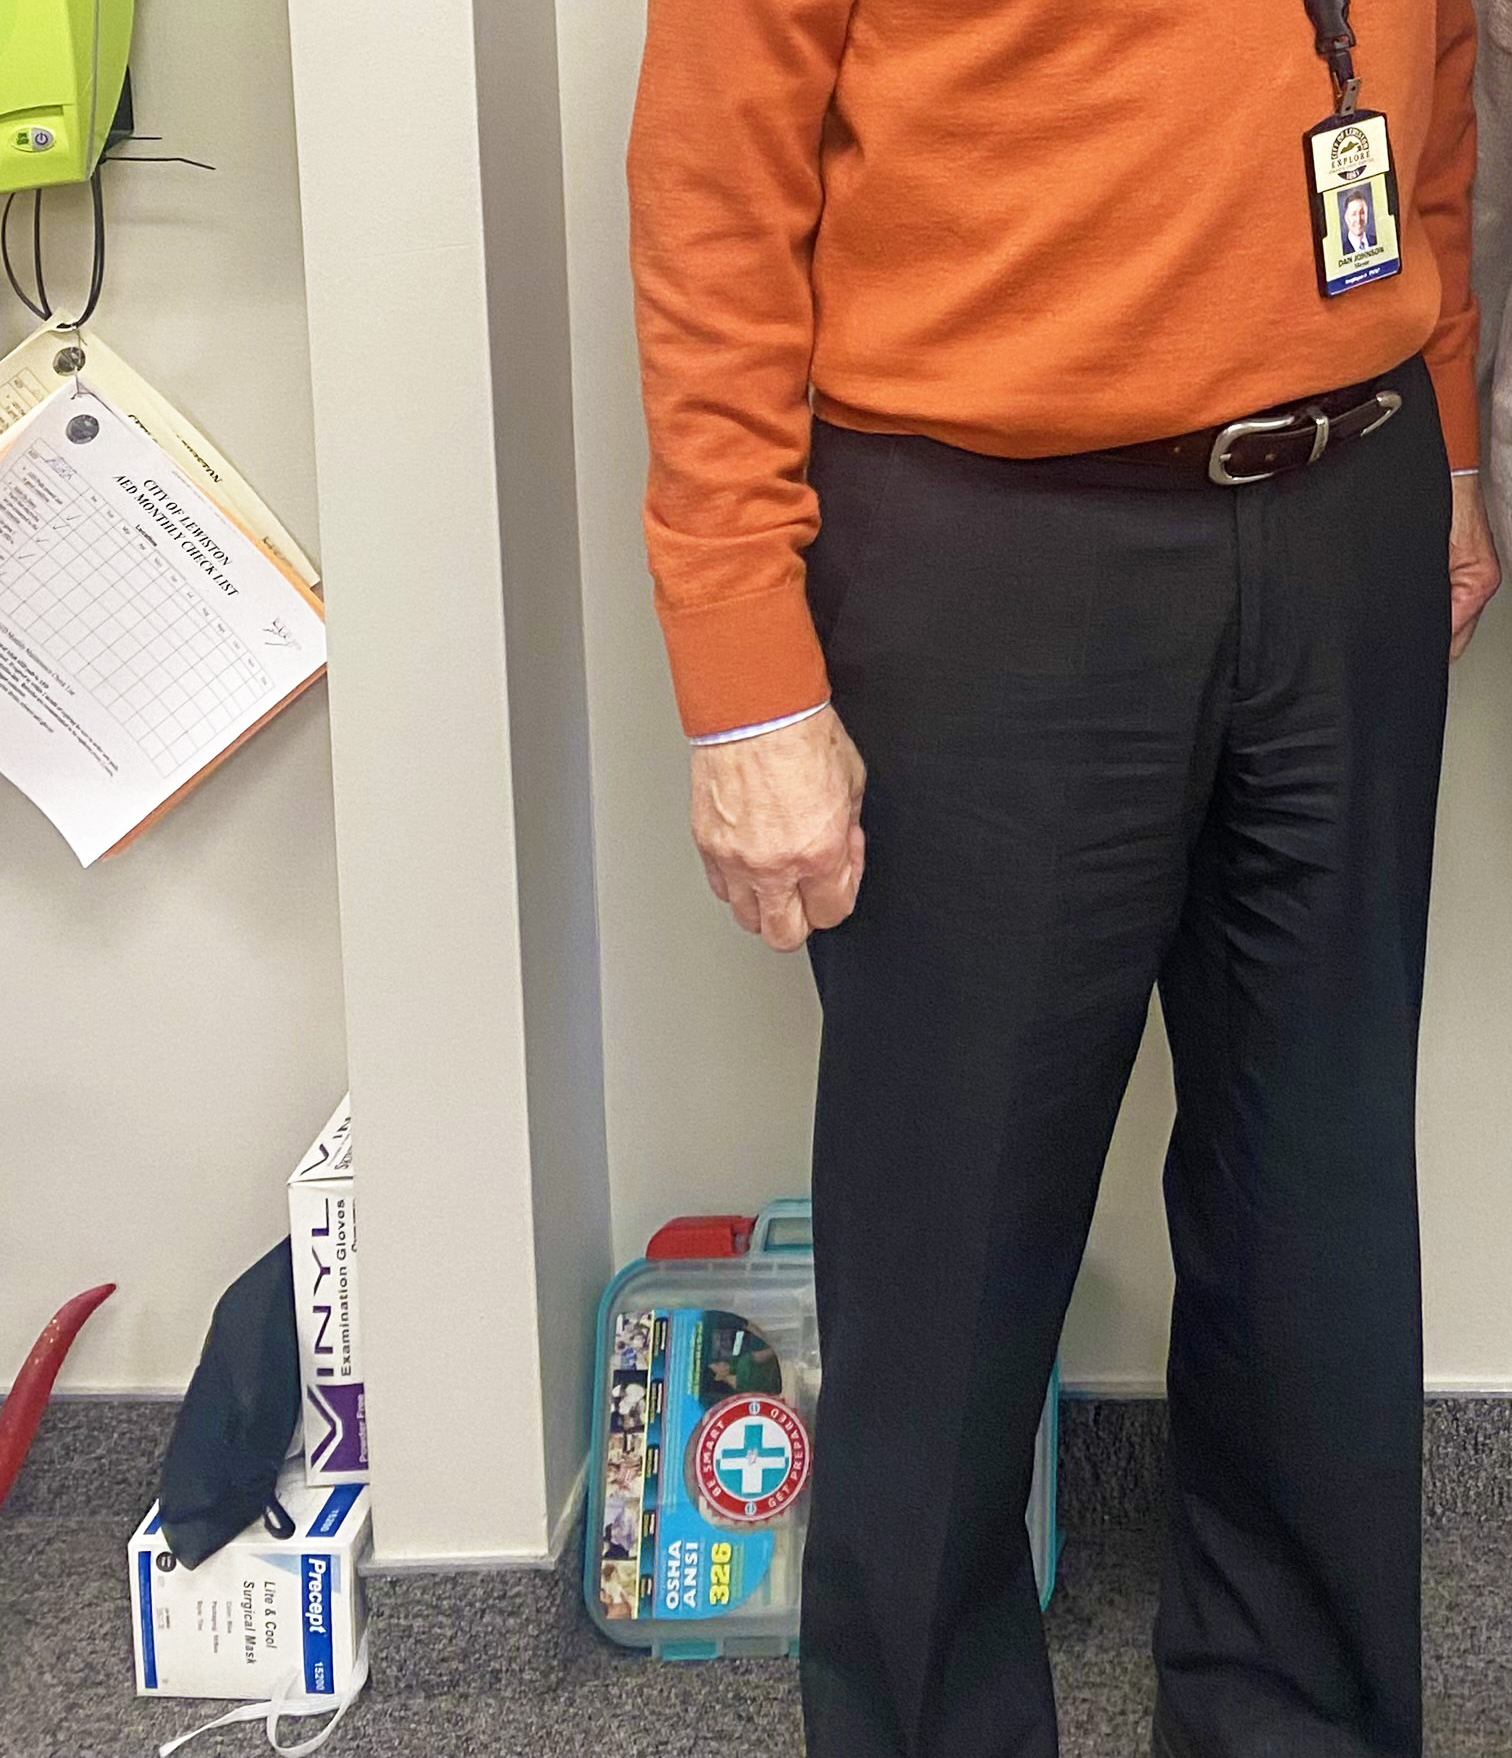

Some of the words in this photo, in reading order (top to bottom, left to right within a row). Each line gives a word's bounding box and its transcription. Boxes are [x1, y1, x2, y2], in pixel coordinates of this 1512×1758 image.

[1331, 151, 1371, 168] EXPLORE
[1338, 257, 1353, 268] DAN
[112, 469, 139, 497] AED
[132, 490, 186, 544] MONTHLY
[179, 538, 218, 577] CHECK
[211, 572, 238, 599] LIST
[141, 476, 171, 506] CITY
[164, 498, 185, 520] OF
[178, 513, 232, 569] LEWISTON
[335, 1198, 349, 1262] Gloves
[307, 1198, 337, 1470] VINYL
[336, 1266, 352, 1377] Examination
[702, 1419, 724, 1473] SMART
[769, 1407, 803, 1480] PREPARED
[706, 1478, 721, 1497] BE
[767, 1483, 790, 1507] GET
[263, 1580, 276, 1604] Lite
[302, 1557, 328, 1634] Precept
[665, 1539, 682, 1609] OSHA
[682, 1541, 698, 1608] ANSI
[708, 1541, 732, 1605] 326
[240, 1580, 256, 1632] Surgical
[264, 1607, 276, 1616] &
[244, 1635, 258, 1665] Mask
[264, 1620, 277, 1648] Cool
[313, 1661, 324, 1690] 15200
